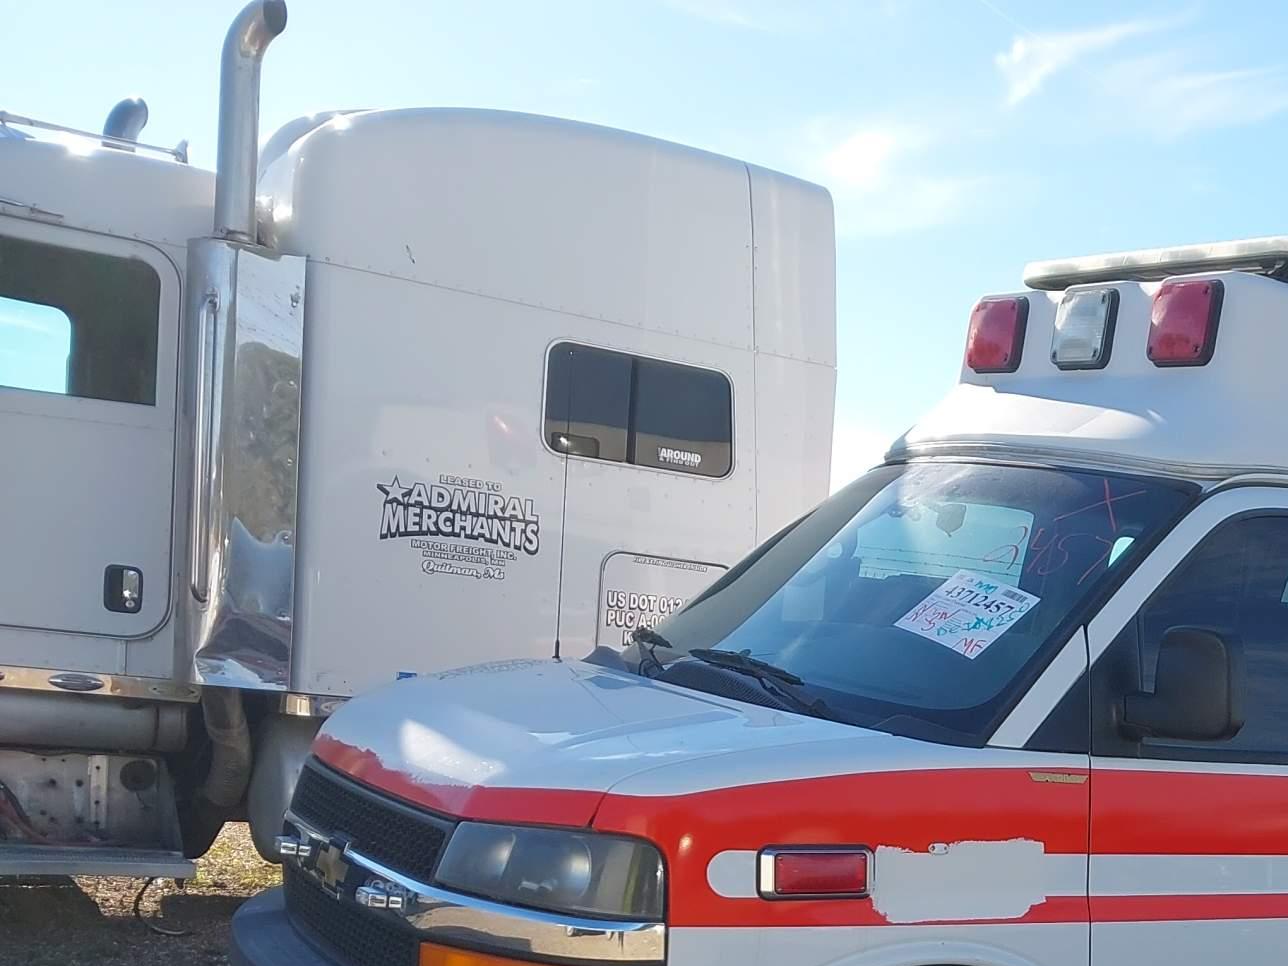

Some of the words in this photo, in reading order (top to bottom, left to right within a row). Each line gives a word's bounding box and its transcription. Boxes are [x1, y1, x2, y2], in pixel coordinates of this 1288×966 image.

[439, 474, 484, 490] LEASED
[486, 481, 503, 492] TO
[408, 482, 540, 523] ADMIRAL
[379, 502, 541, 555] MERCHANTS
[410, 539, 449, 552] MOTOR
[496, 550, 518, 561] INC.
[983, 525, 1114, 586] 2457
[421, 560, 482, 580] Quitman,
[483, 566, 505, 580] Ms
[491, 557, 506, 567] MN
[606, 589, 626, 609] US
[629, 592, 658, 612] DOT
[944, 585, 1016, 616] 43712457
[606, 609, 636, 629] PUC
